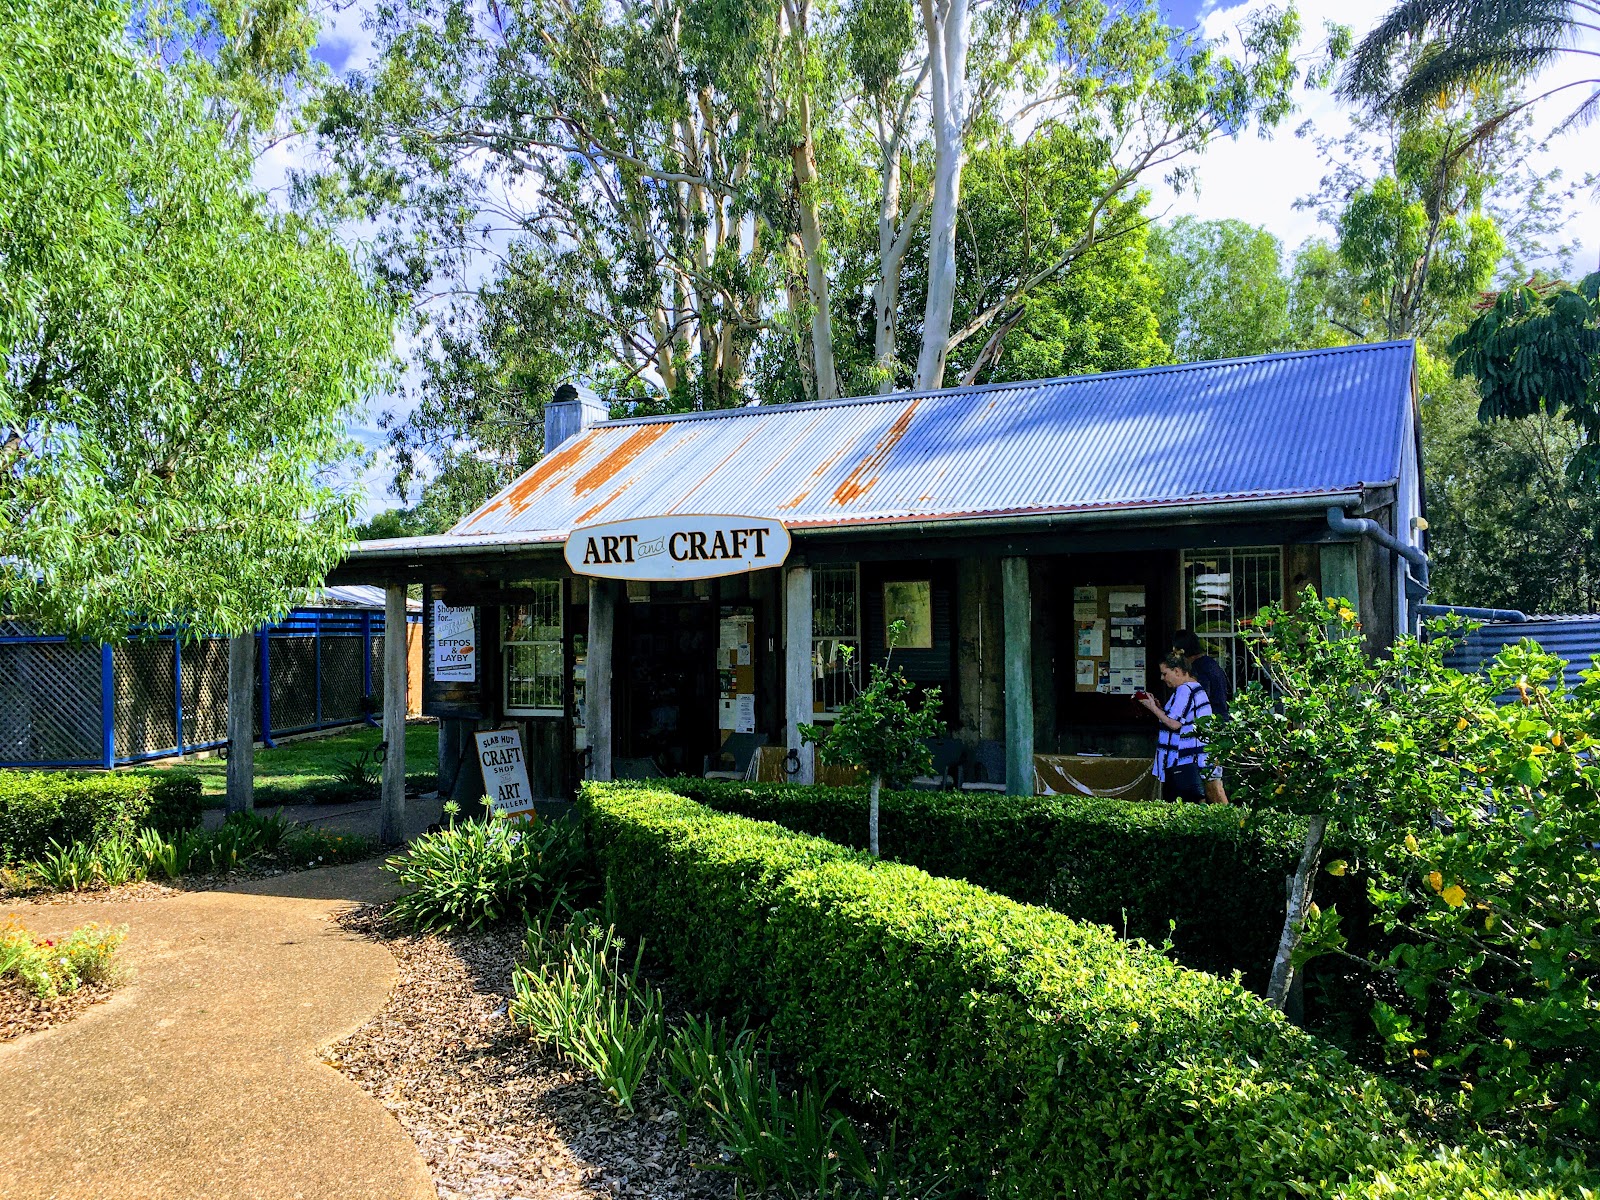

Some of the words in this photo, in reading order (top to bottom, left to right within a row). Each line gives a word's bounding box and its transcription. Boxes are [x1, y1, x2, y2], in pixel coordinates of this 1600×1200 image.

[583, 534, 638, 565] ART
[636, 536, 667, 558] and
[668, 527, 770, 562] CRAFT
[438, 605, 455, 615] Shop
[438, 639, 471, 647] EFTPOS
[440, 654, 469, 662] LAYBY
[483, 736, 499, 748] SLAB
[501, 735, 515, 745] HUT
[482, 747, 521, 767] CRAFT
[493, 766, 515, 774] SHOP
[498, 783, 520, 801] ART
[493, 799, 528, 810] GALLERY
